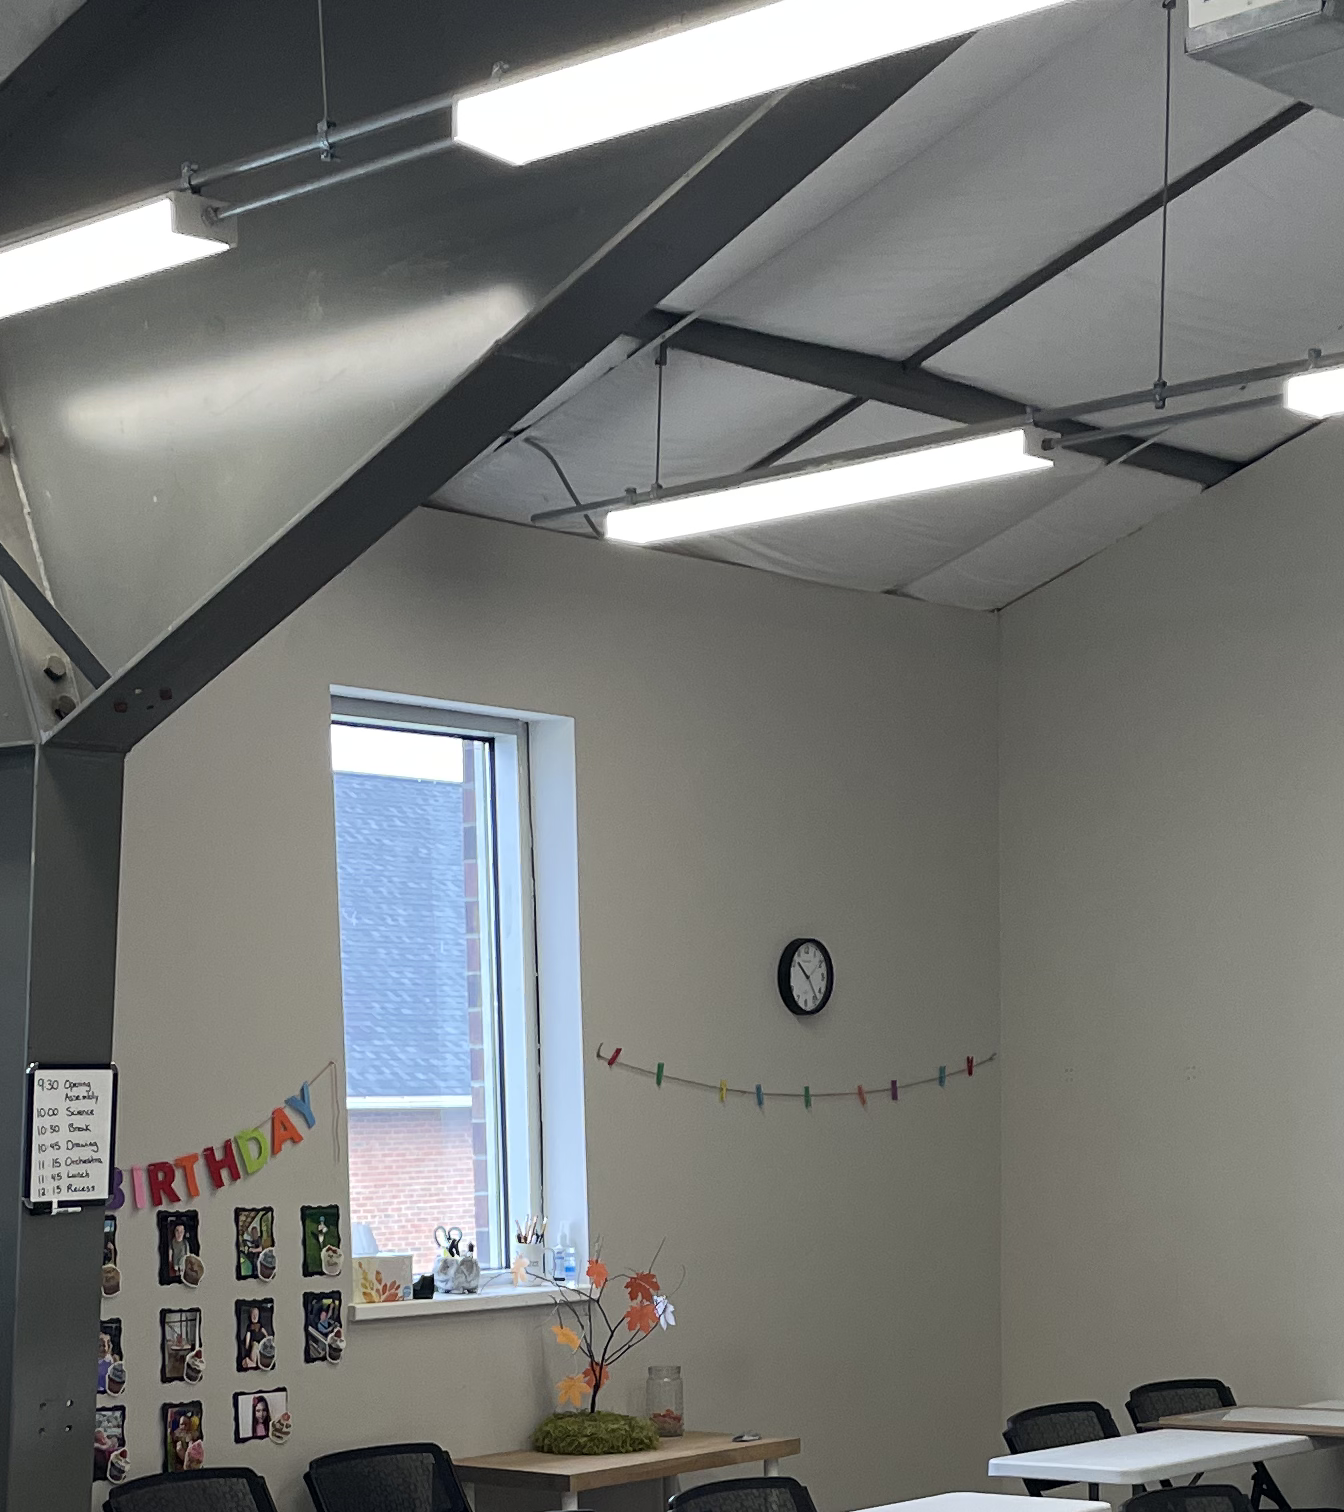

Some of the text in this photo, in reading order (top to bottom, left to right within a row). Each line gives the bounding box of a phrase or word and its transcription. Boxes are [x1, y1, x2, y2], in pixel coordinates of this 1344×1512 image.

[65, 1106, 95, 1117] Science
[68, 1122, 92, 1132] Break
[66, 1140, 99, 1153] Drawing
[64, 1155, 104, 1166] Orchestra
[67, 1169, 90, 1179] Lunch
[67, 1185, 96, 1193] Recess
